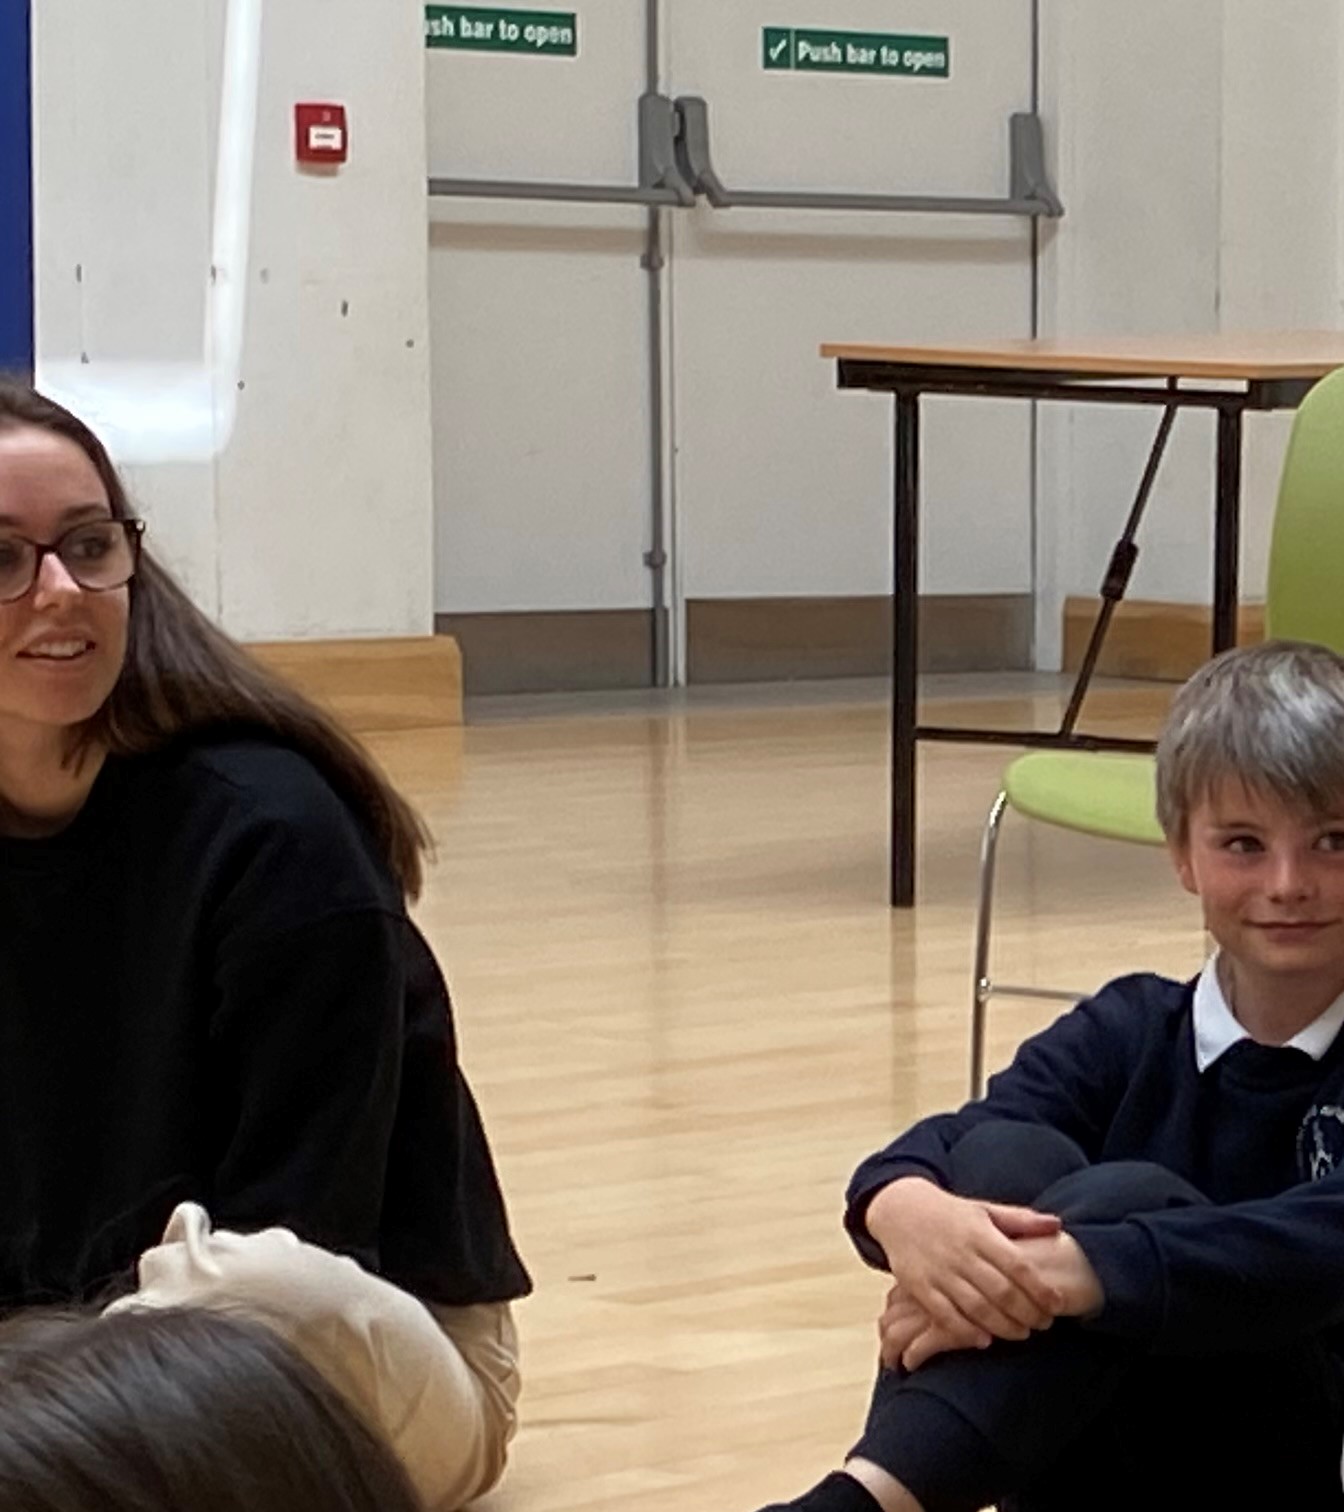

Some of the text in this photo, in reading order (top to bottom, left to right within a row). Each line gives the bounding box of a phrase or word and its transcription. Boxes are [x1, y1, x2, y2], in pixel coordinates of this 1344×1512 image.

[460, 15, 494, 39] bar
[498, 18, 520, 41] to
[523, 24, 573, 48] open
[798, 40, 946, 73] Push bar to open
